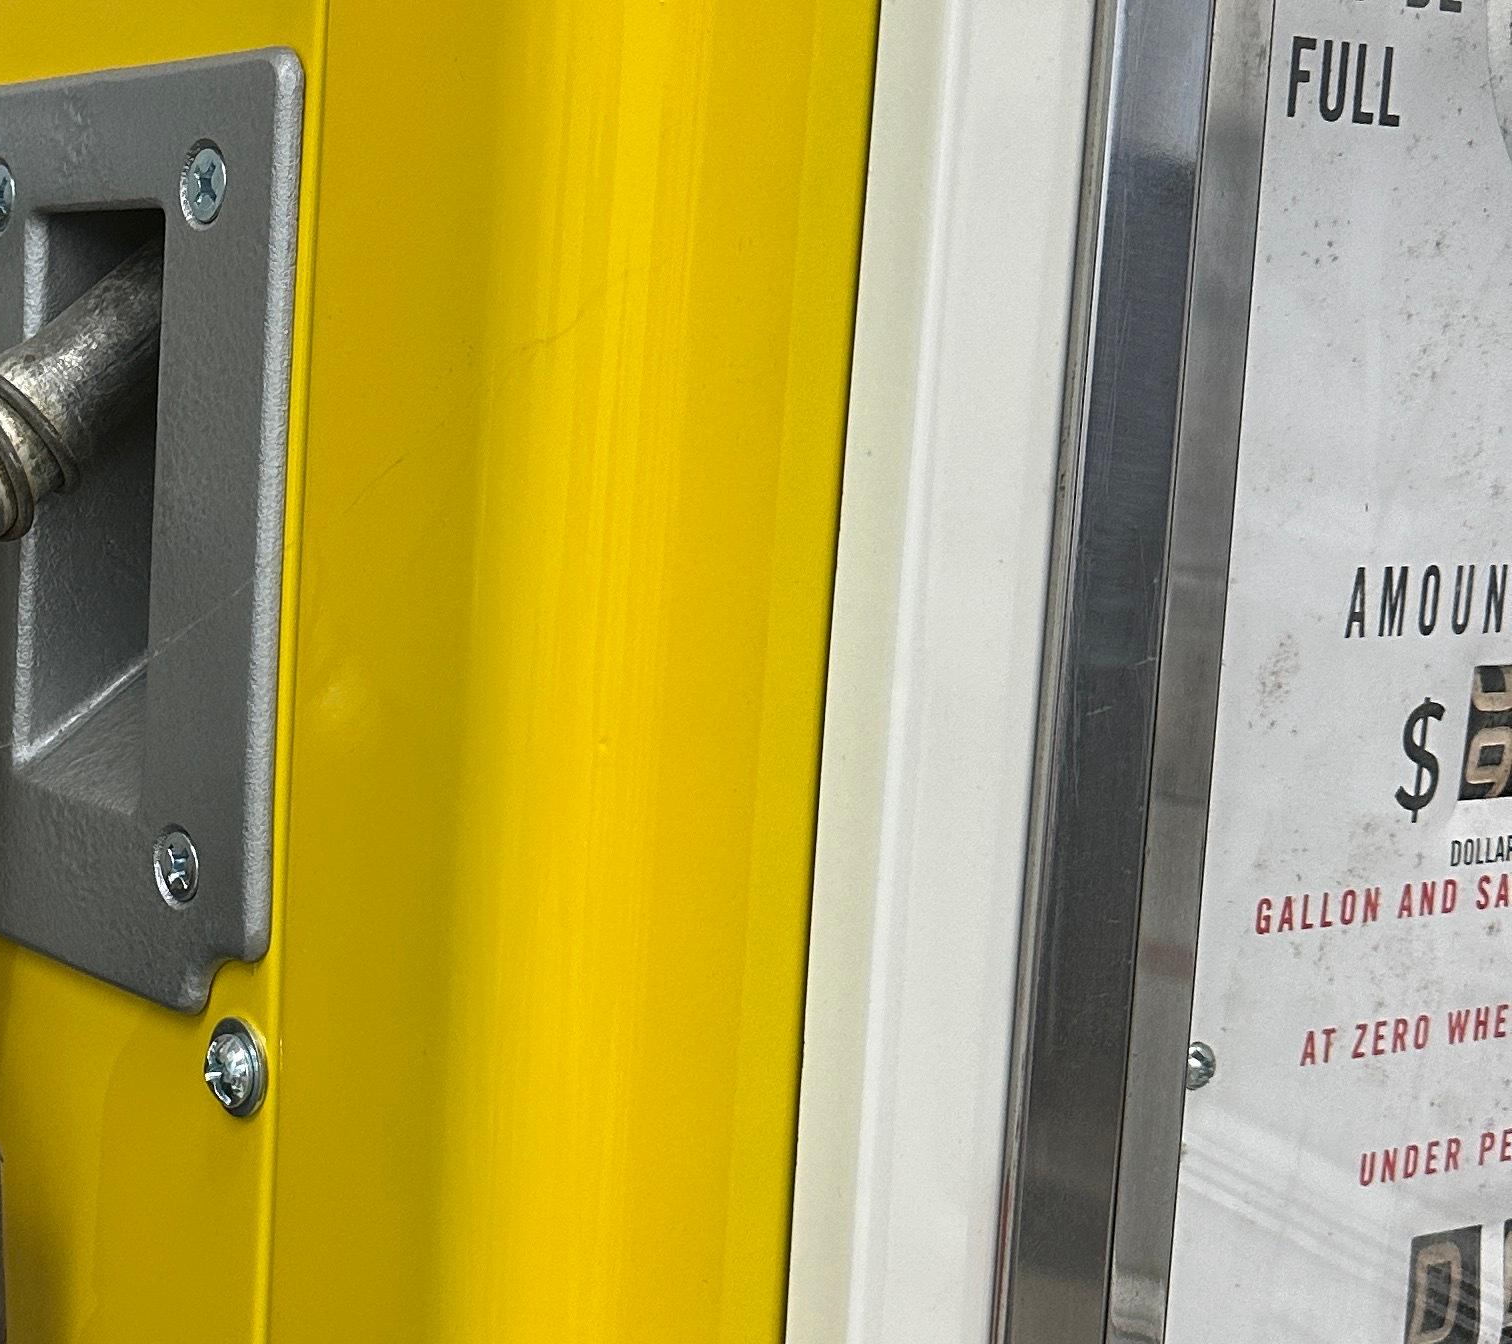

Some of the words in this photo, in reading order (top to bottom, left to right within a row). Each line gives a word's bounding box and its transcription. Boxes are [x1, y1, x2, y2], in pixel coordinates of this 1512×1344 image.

[1287, 35, 1400, 127] FULL
[1344, 564, 1509, 639] AMOUN
[1394, 697, 1447, 824] $
[1254, 886, 1381, 935] GALLON
[1396, 878, 1458, 920] AND
[1300, 1027, 1337, 1067] AT
[1351, 1014, 1431, 1060] ZERO
[1447, 1004, 1510, 1046] WHE
[1358, 1136, 1463, 1187] UNDER
